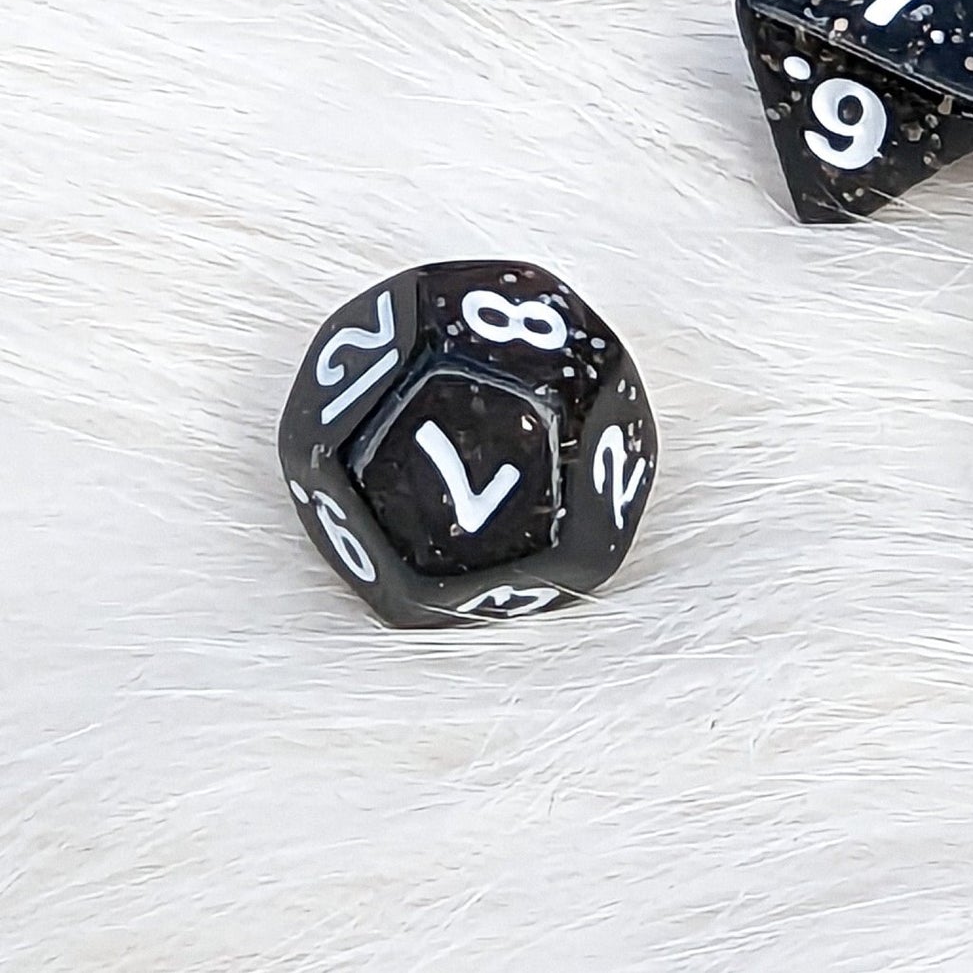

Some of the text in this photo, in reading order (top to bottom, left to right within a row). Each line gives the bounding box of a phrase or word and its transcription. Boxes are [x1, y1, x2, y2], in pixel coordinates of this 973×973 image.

[316, 290, 399, 425] 12
[461, 289, 568, 350] 8
[415, 420, 521, 533] 7
[592, 424, 646, 530] 2
